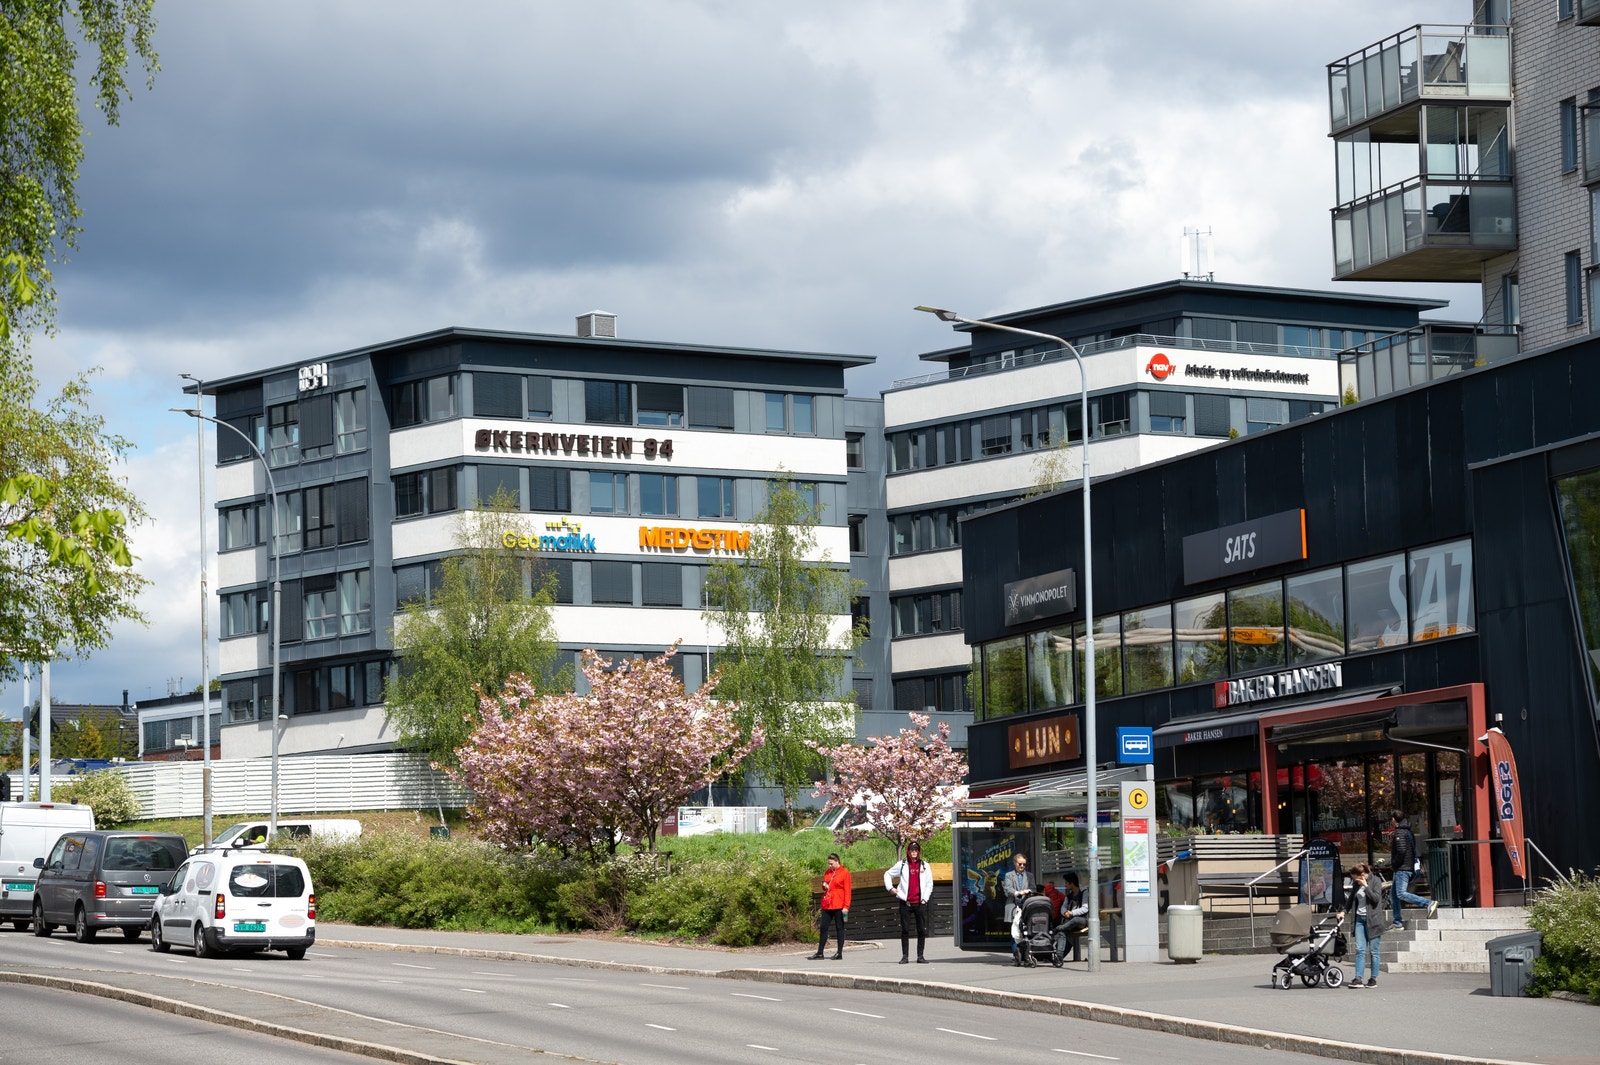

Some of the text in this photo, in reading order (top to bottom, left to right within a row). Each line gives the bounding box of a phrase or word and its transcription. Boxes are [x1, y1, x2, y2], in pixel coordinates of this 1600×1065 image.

[475, 429, 673, 458] ØKERNVEIEN 94
[502, 530, 596, 550] Geomatikk
[1224, 532, 1256, 563] SATS
[1020, 585, 1067, 607] VINMONOPOLET
[1228, 662, 1342, 705] BAKER HANSEN
[1025, 725, 1060, 758] LUN
[1187, 729, 1223, 742] BAKER HANSEN
[1134, 793, 1143, 805] C
[976, 848, 1011, 870] PIKACHU
